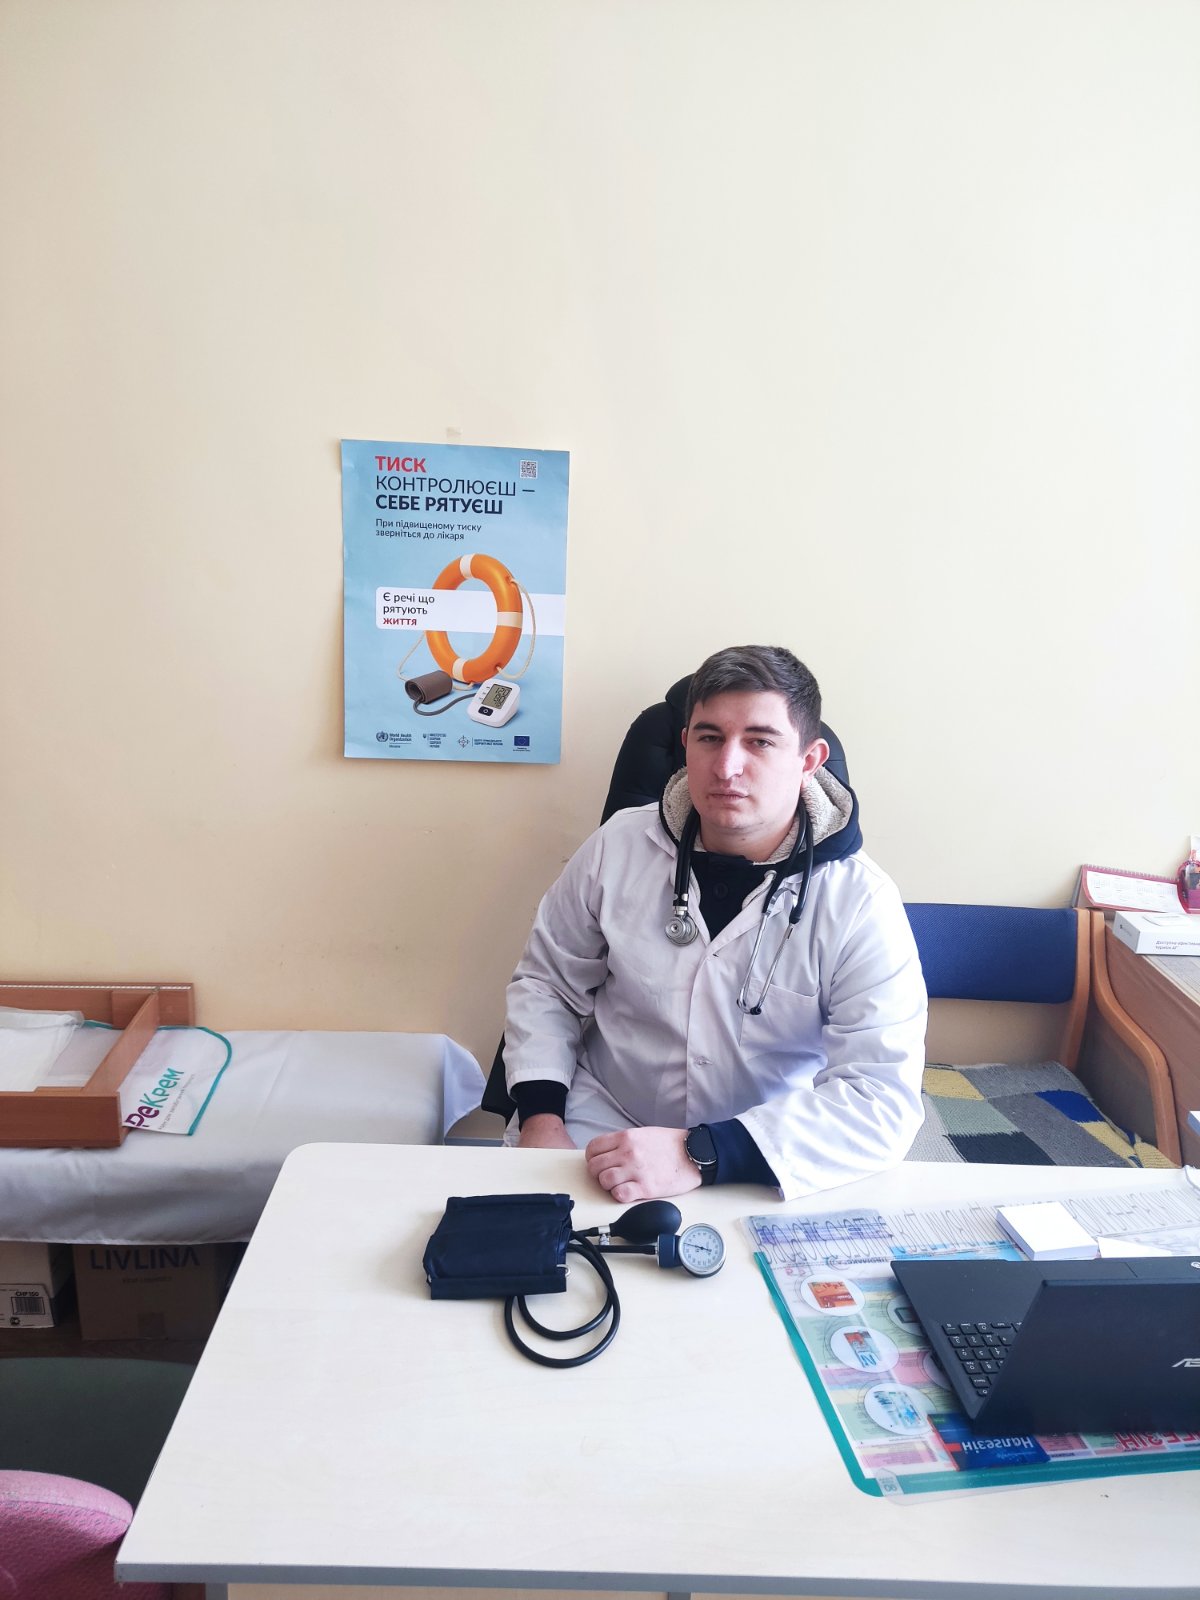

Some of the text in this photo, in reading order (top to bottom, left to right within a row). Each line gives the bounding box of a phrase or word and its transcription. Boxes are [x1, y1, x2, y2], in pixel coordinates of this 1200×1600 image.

[375, 456, 426, 473] ТИСК
[376, 475, 516, 496] КОНТРОЛЮЄШ
[375, 494, 503, 515] СЕБЕ РЯТУЄШ
[375, 518, 482, 533] При підвищеному тиску
[375, 530, 465, 541] зверніться до лікаря
[383, 592, 435, 605] Є речі що
[383, 606, 428, 617] рятують
[383, 617, 417, 626] життя
[962, 1436, 1034, 1454] Налгезін
